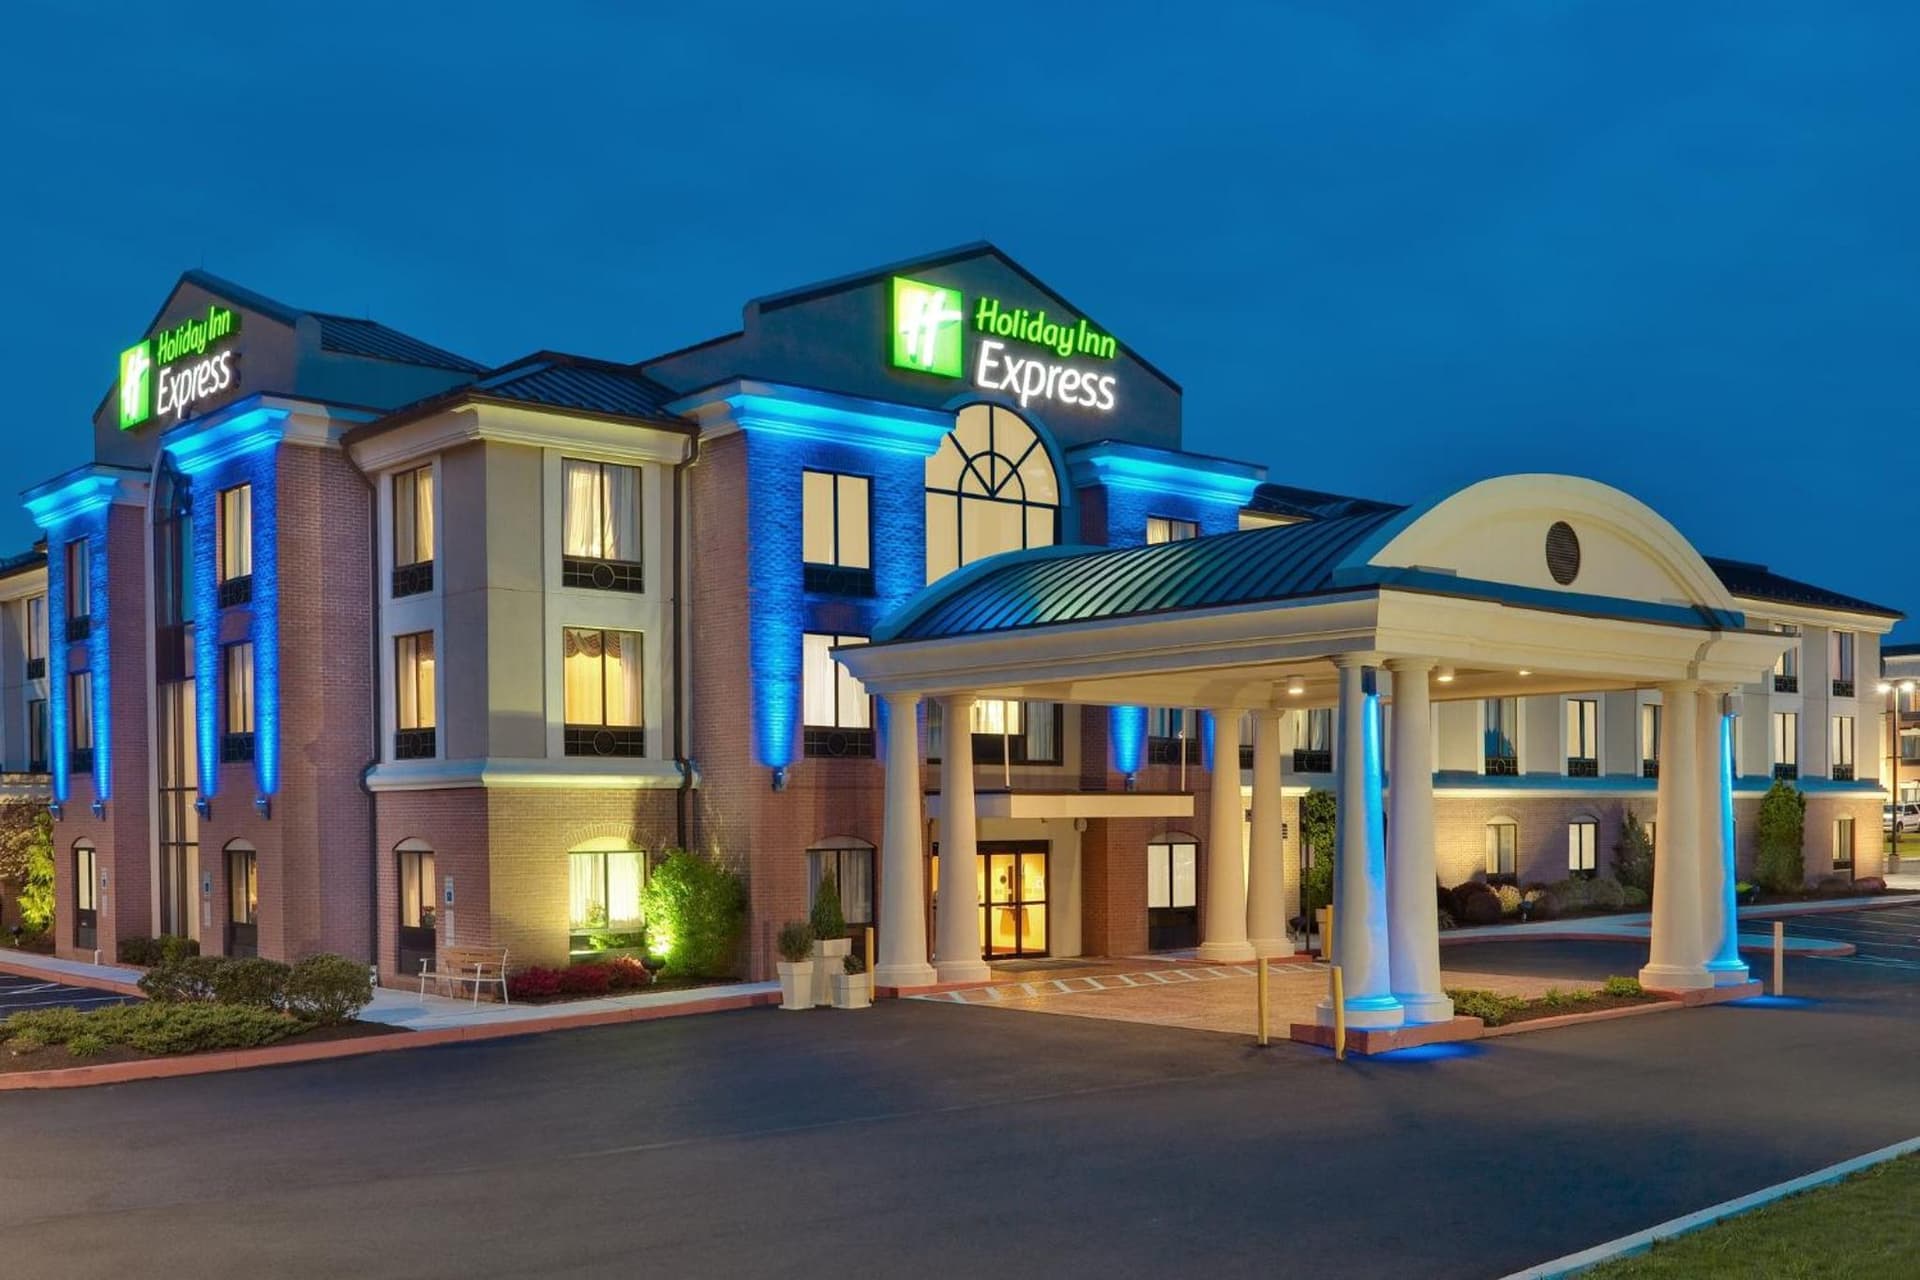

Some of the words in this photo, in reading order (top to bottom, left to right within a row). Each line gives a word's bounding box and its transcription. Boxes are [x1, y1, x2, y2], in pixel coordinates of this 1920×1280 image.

[157, 319, 207, 366] Holiday
[208, 305, 231, 340] Inn
[976, 297, 1075, 357] Holiday
[1077, 319, 1116, 359] Inn
[156, 350, 231, 419] Express
[976, 340, 1116, 410] Express
